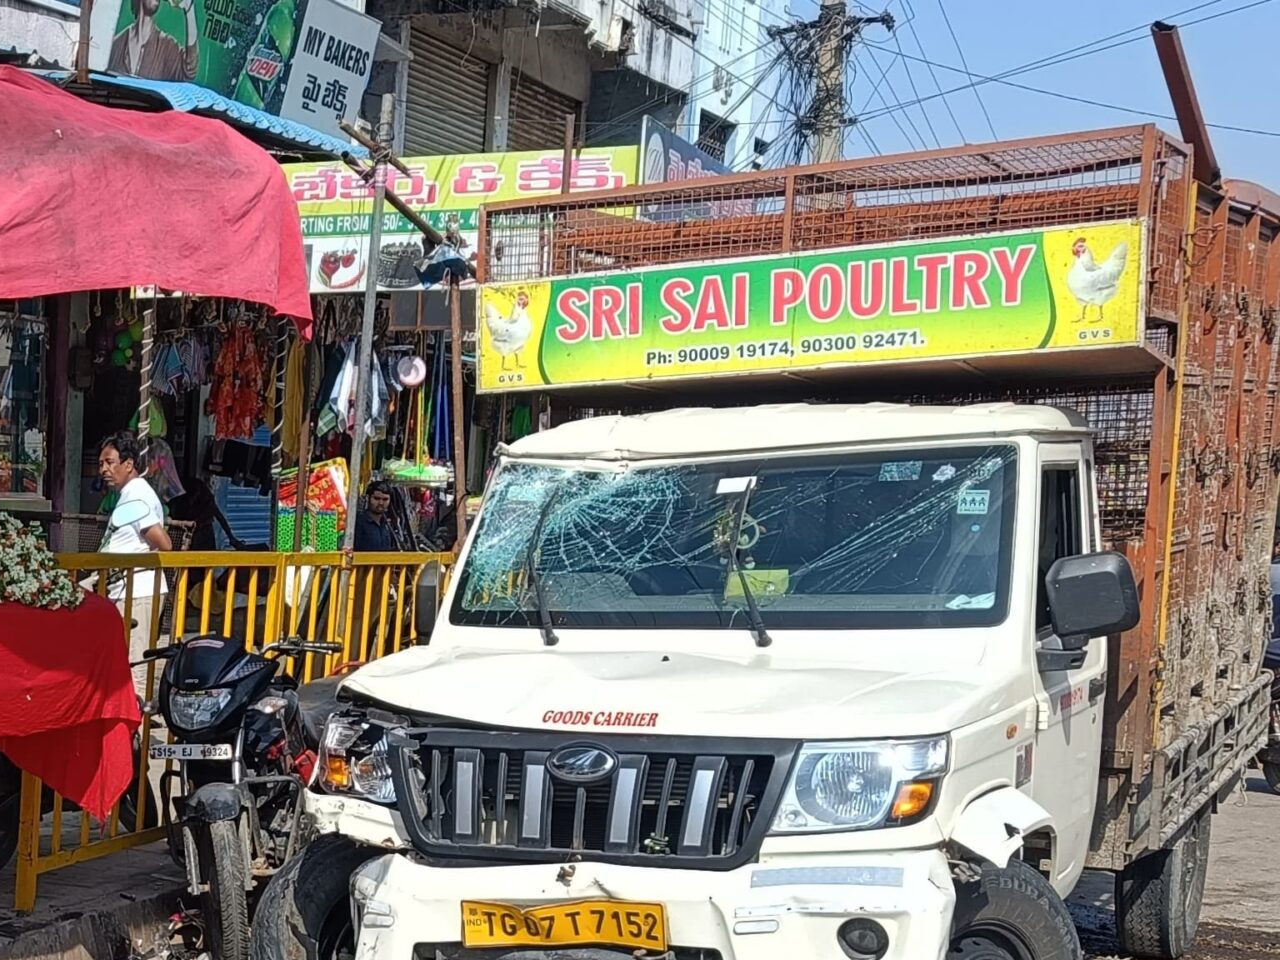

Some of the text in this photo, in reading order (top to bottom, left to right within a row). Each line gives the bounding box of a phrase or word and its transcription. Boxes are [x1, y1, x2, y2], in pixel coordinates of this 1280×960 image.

[303, 25, 370, 77] MY BAKERS
[556, 246, 1035, 342] SRI SAI POULTRY
[646, 331, 925, 365] Ph: 90009 19174, 90300 92471.
[542, 710, 659, 727] GOODS CARRIER
[182, 747, 193, 757] EJ
[466, 918, 482, 927] IND
[482, 911, 518, 937] TG
[565, 911, 581, 936] T
[589, 909, 659, 942] 7152
